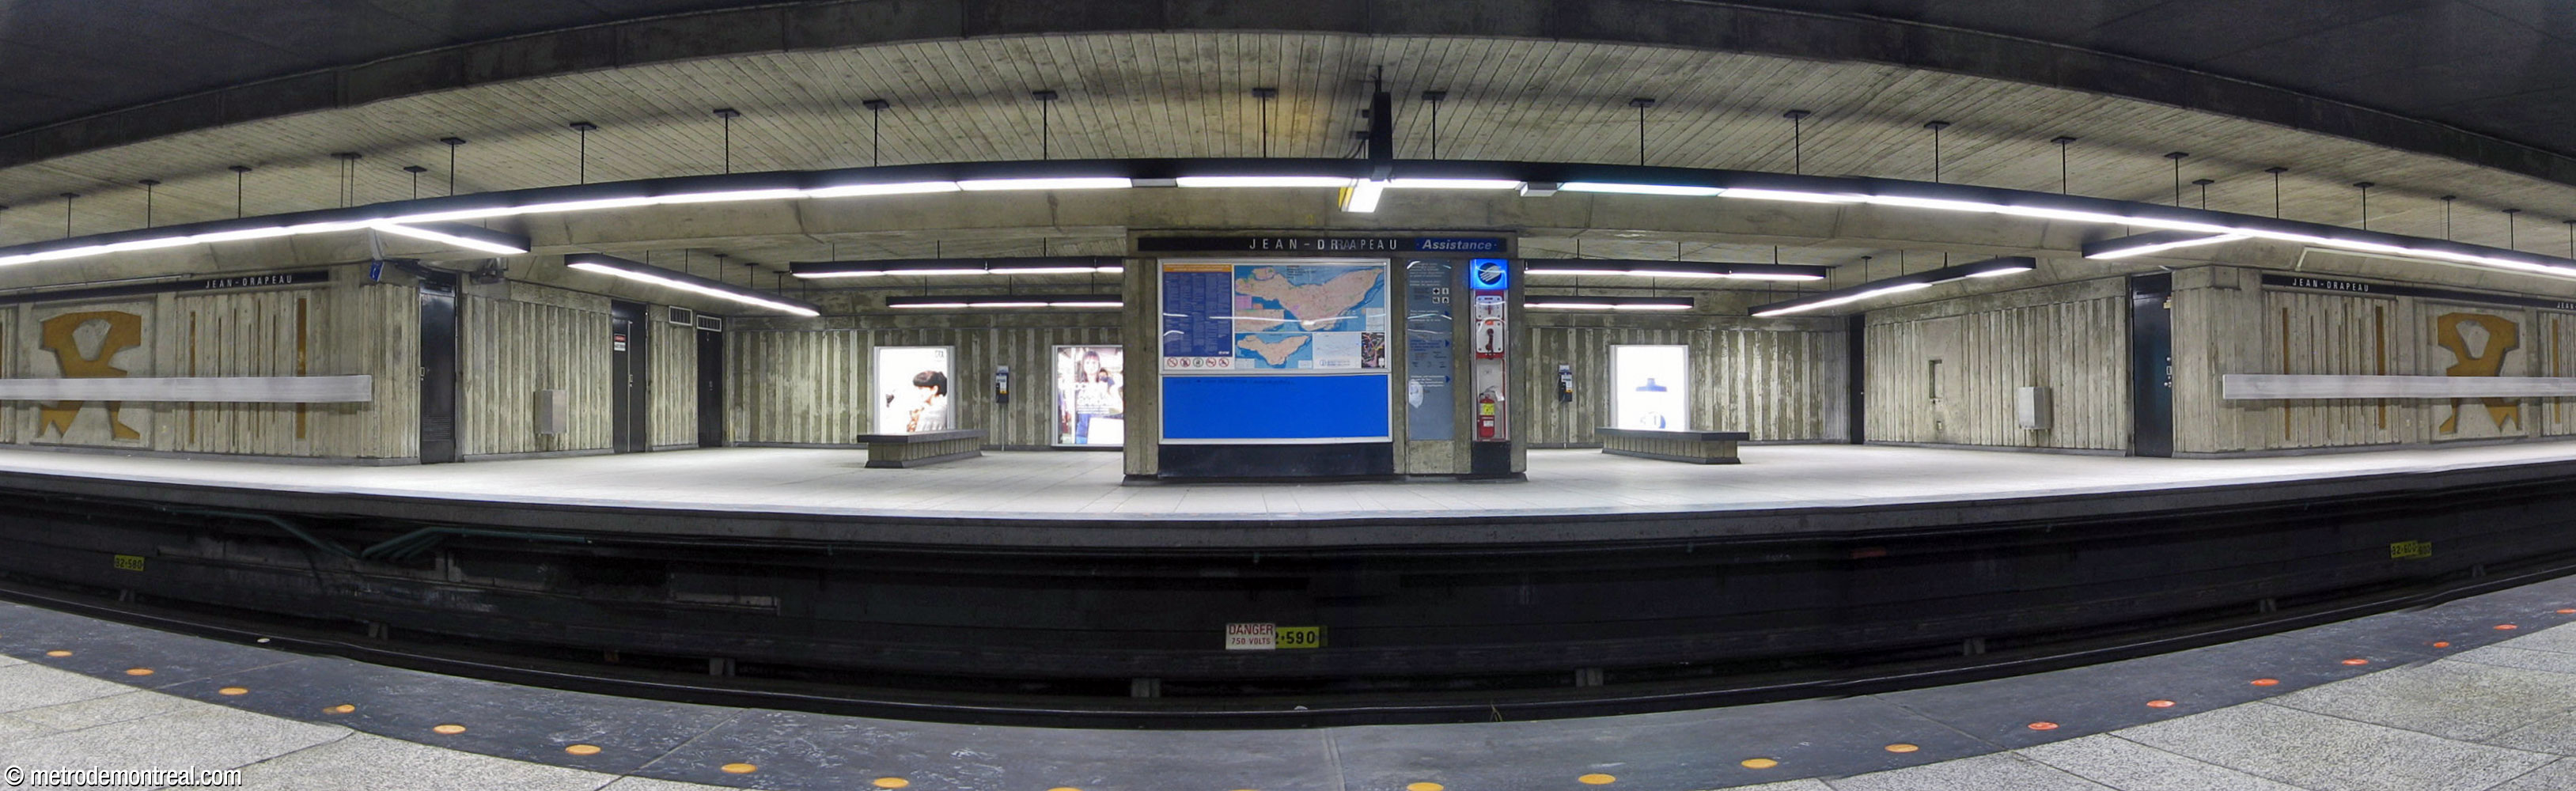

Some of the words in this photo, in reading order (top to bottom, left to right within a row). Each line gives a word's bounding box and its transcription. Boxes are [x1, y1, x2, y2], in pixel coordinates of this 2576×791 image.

[1422, 239, 1492, 250] Assistance
[206, 275, 293, 289] JEAN-DRAPEAU
[2293, 278, 2369, 292] JEAN-DRAPEAU
[1229, 624, 1274, 635] DANGER
